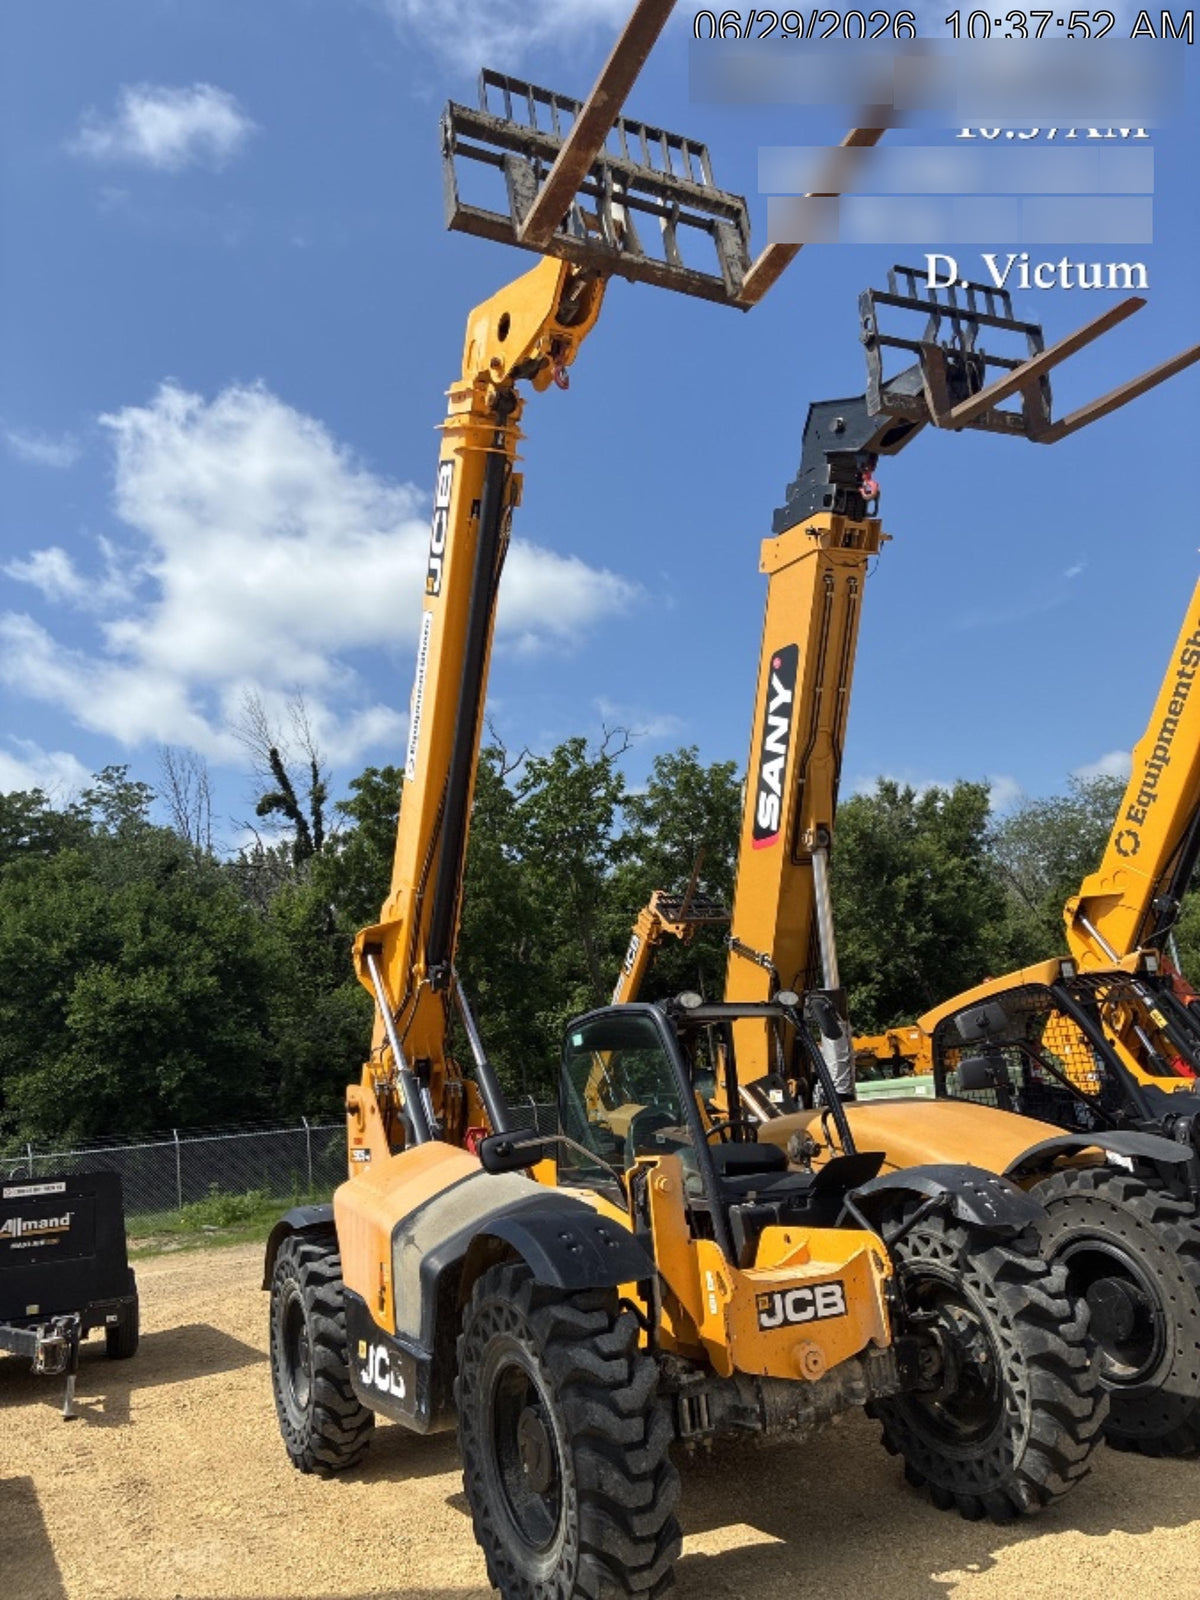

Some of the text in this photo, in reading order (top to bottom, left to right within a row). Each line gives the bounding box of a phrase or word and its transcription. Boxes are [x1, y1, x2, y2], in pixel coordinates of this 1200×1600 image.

[426, 460, 454, 596] JCB
[757, 671, 793, 832] SANY
[1126, 617, 1200, 828] EquipmentSh
[0, 1212, 70, 1238] Allmand
[758, 1283, 847, 1328] JCB
